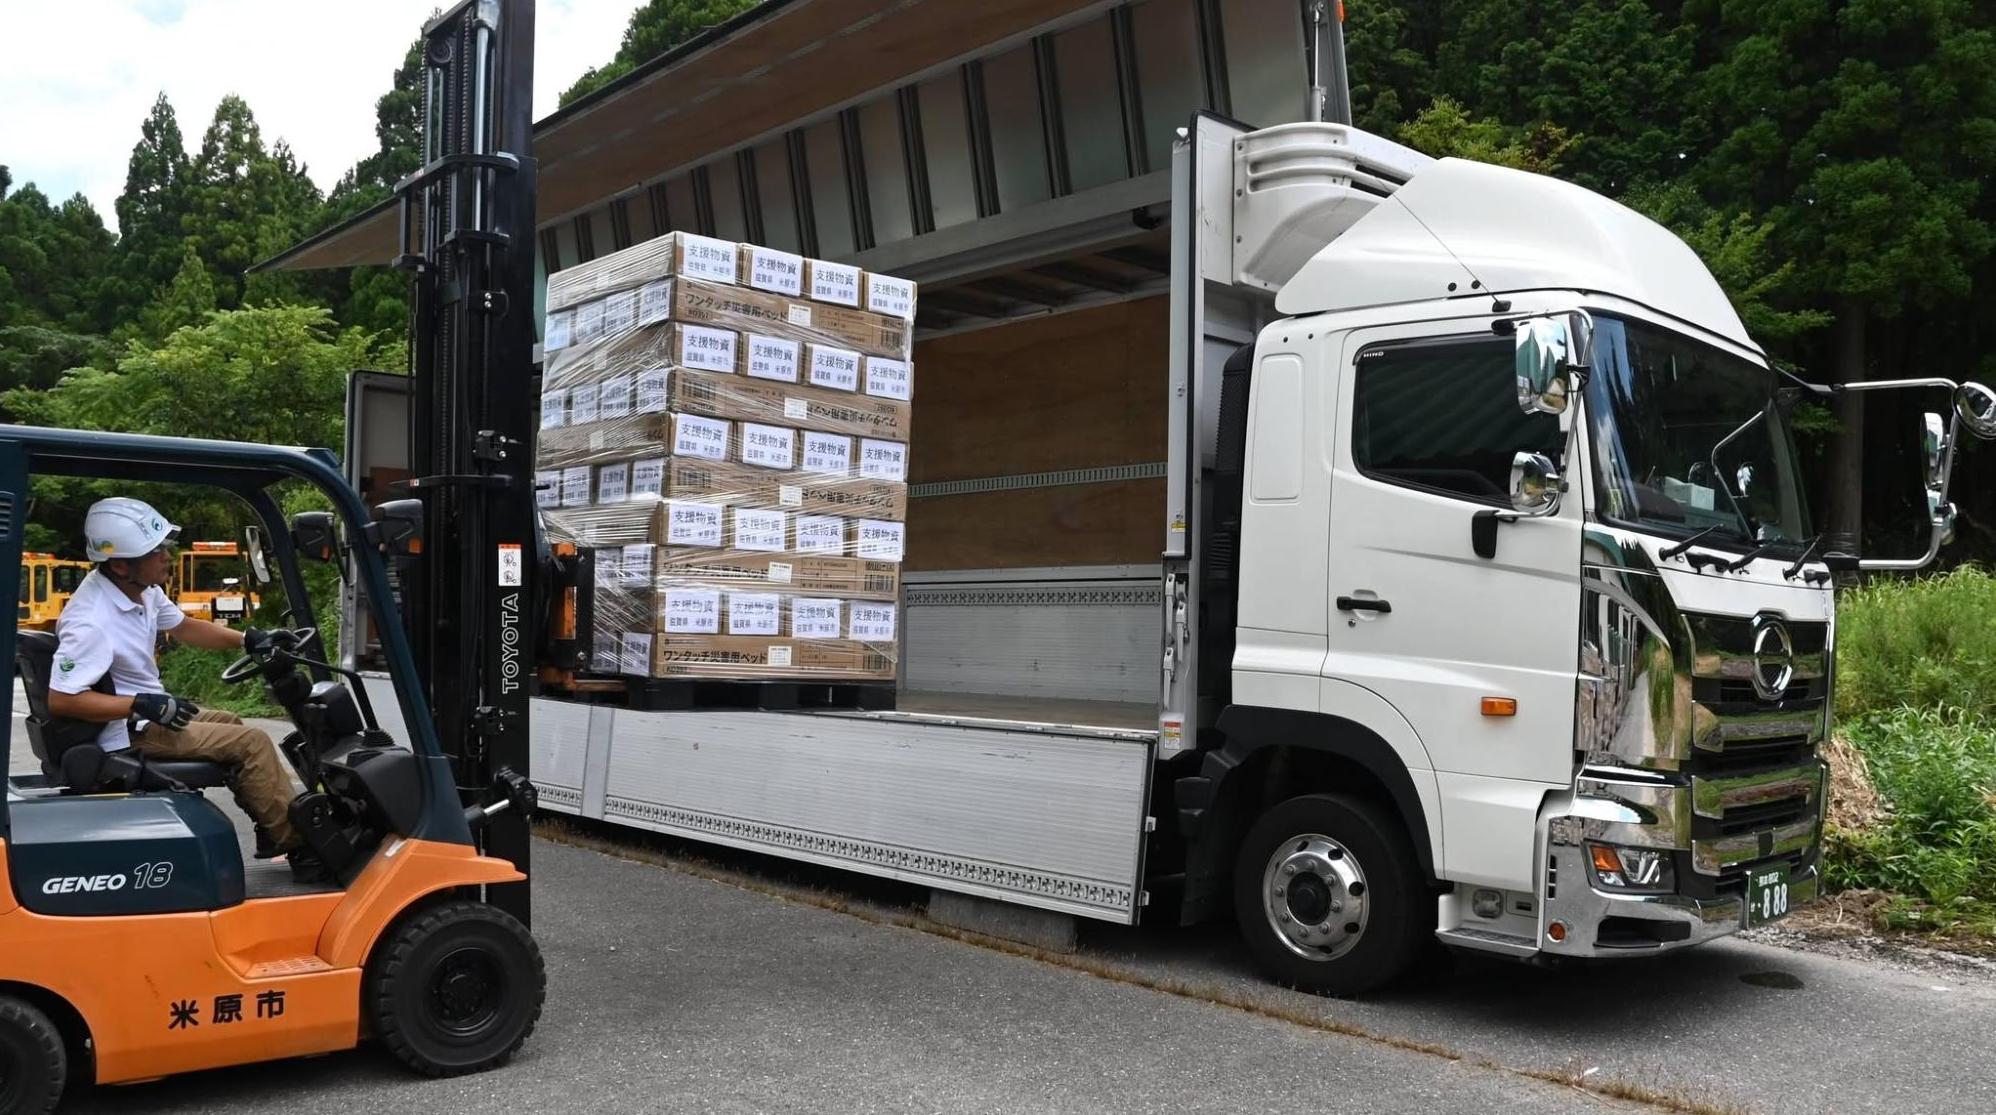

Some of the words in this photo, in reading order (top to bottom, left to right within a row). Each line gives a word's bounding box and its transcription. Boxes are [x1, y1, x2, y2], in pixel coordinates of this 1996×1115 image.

[688, 244, 731, 263] 支援物資
[757, 256, 797, 275] 支援物資
[816, 269, 854, 286] 支援物資
[873, 282, 909, 298] 支援物資
[687, 335, 730, 352] 支援物資
[753, 344, 793, 362] 支援物資
[816, 354, 855, 372] 支援物資
[870, 366, 906, 381] 支援物資
[682, 423, 723, 441] 支援物資
[749, 432, 788, 449] 支援物資
[808, 440, 846, 457] 支援物資
[865, 448, 901, 462] 支援物資
[674, 511, 717, 526] 支援物資
[796, 606, 836, 619] 支援物資
[854, 608, 891, 622] 支援物資
[501, 592, 519, 694] TOYOTA
[664, 650, 767, 664] ワンタッチ災害用ベッド
[42, 873, 127, 896] GENEO
[133, 861, 174, 890] 18
[1763, 883, 1788, 919] 888
[168, 989, 287, 1031] 米原市
